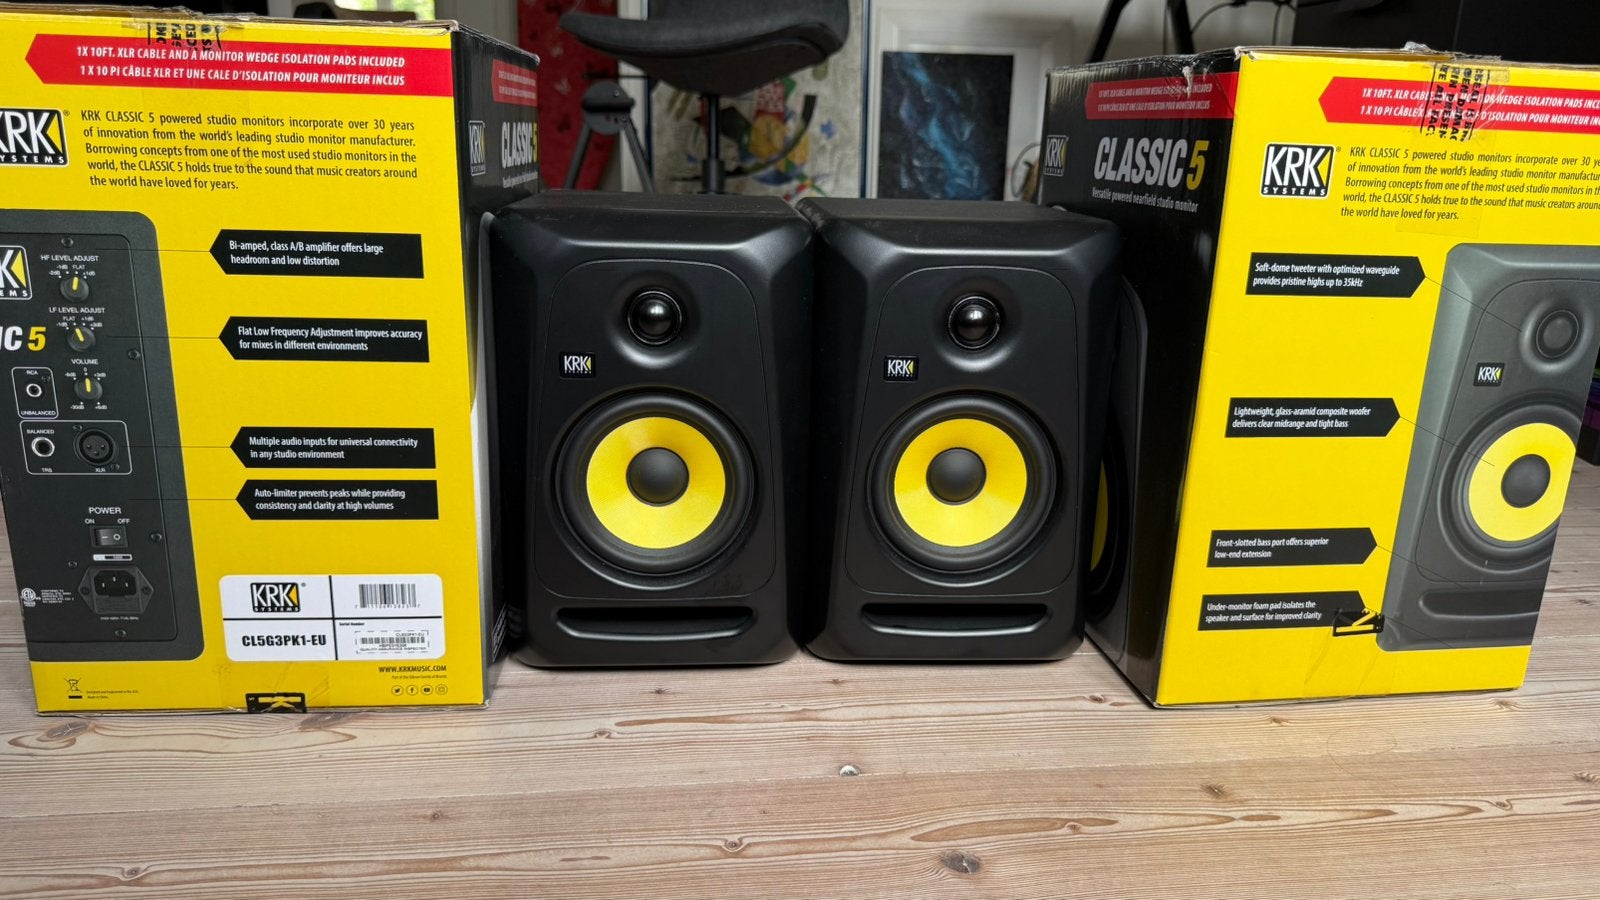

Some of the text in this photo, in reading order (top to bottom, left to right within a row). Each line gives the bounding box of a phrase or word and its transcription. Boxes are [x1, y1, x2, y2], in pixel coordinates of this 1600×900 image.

[77, 47, 405, 67] 1X 10FT. XLR CABLE AND A MONITOR WEDGE ISOLATION PADS INCLUDED
[81, 66, 404, 85] 1 X 10 PI CÂBLE XLR ET UNE CALE D'ISOLATION POUR MONITEUR INCLUS
[81, 110, 414, 132] KRK CLASSIC 5 powered studio monitors incorporate over 30 years
[84, 126, 415, 146] of innovation from the world's leading studio monitor manufacturer.
[502, 122, 532, 168] CLASSIC
[0, 155, 64, 163] YSTEMS
[1045, 138, 1064, 167] KRK
[1094, 136, 1209, 190] CLASSIC 5
[1265, 146, 1325, 187] KRK
[1263, 187, 1325, 196] SYSTEMS
[1092, 187, 1198, 212] Versatile powered nearfield studio monitor
[1341, 207, 1459, 221] the world have loved for years.
[230, 240, 383, 255] Bi-amped, class A/B amplifier offers large
[231, 254, 339, 265] headroom and low distortion
[1255, 263, 1400, 276] Soft-dome tweeter with optimized waveguide
[1253, 276, 1281, 287] provides
[1281, 277, 1306, 287] pristine
[1307, 277, 1325, 288] highs
[1325, 280, 1334, 288] up
[1343, 278, 1363, 286] 35kHz
[28, 327, 46, 351] 5
[564, 355, 588, 371] KRK
[888, 360, 911, 375] KRK
[1478, 367, 1499, 381] KRK
[1234, 407, 1371, 417] Lightweight, glass-aramid composite woofer
[1232, 419, 1348, 429] delivers clear midrange and tight bass
[250, 437, 418, 448] Multiple audio inputs for universal connectivity
[250, 450, 344, 460] in any studio environment
[1216, 538, 1257, 547] Front-slotted
[1257, 538, 1271, 547] bass
[1271, 539, 1285, 547] port
[1304, 538, 1329, 546] superior
[1215, 550, 1272, 558] low-end extension
[252, 584, 294, 606] KRK
[1207, 603, 1253, 611] Under-monitor
[1253, 602, 1270, 610] foam
[1269, 602, 1282, 610] pad
[1281, 601, 1305, 609] isolates
[1206, 614, 1230, 623] speaker
[1242, 613, 1264, 621] surface
[1274, 612, 1303, 621] improved
[1302, 612, 1322, 620] clarity
[242, 635, 326, 647] CL5G3PK1-EU
